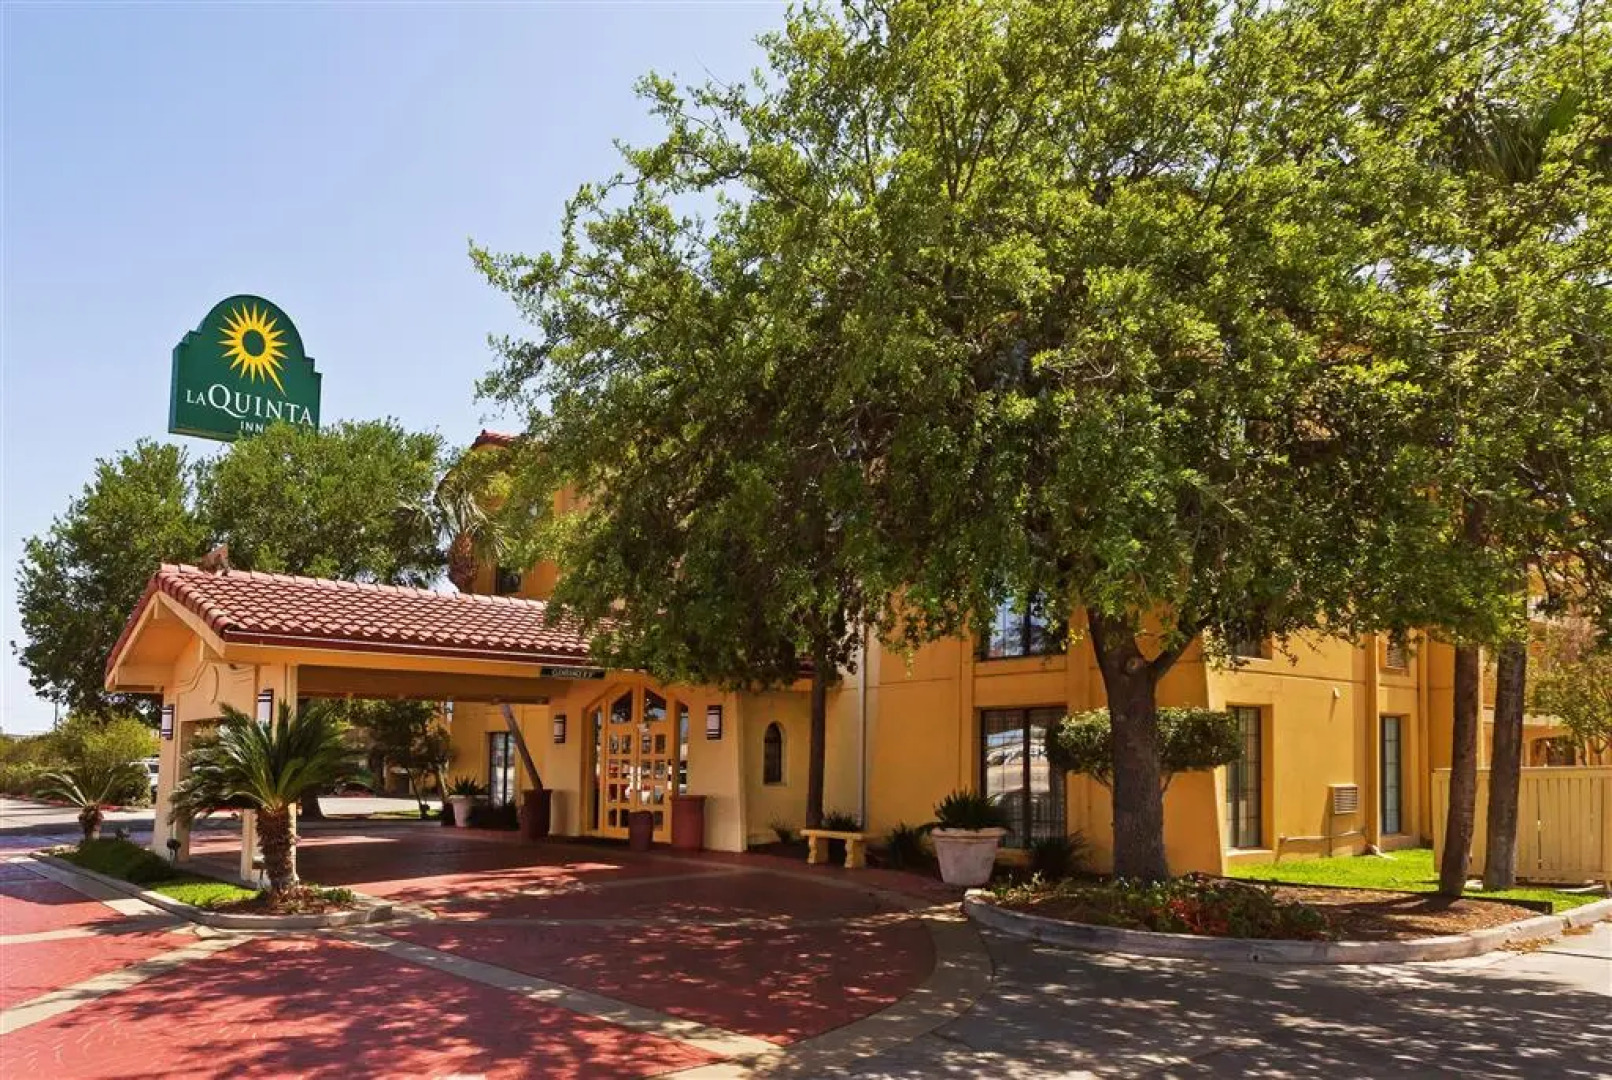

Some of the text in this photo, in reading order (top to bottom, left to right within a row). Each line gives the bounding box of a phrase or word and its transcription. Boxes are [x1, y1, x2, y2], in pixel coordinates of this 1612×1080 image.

[186, 383, 314, 426] LA QUINTA
[240, 420, 264, 433] INN
